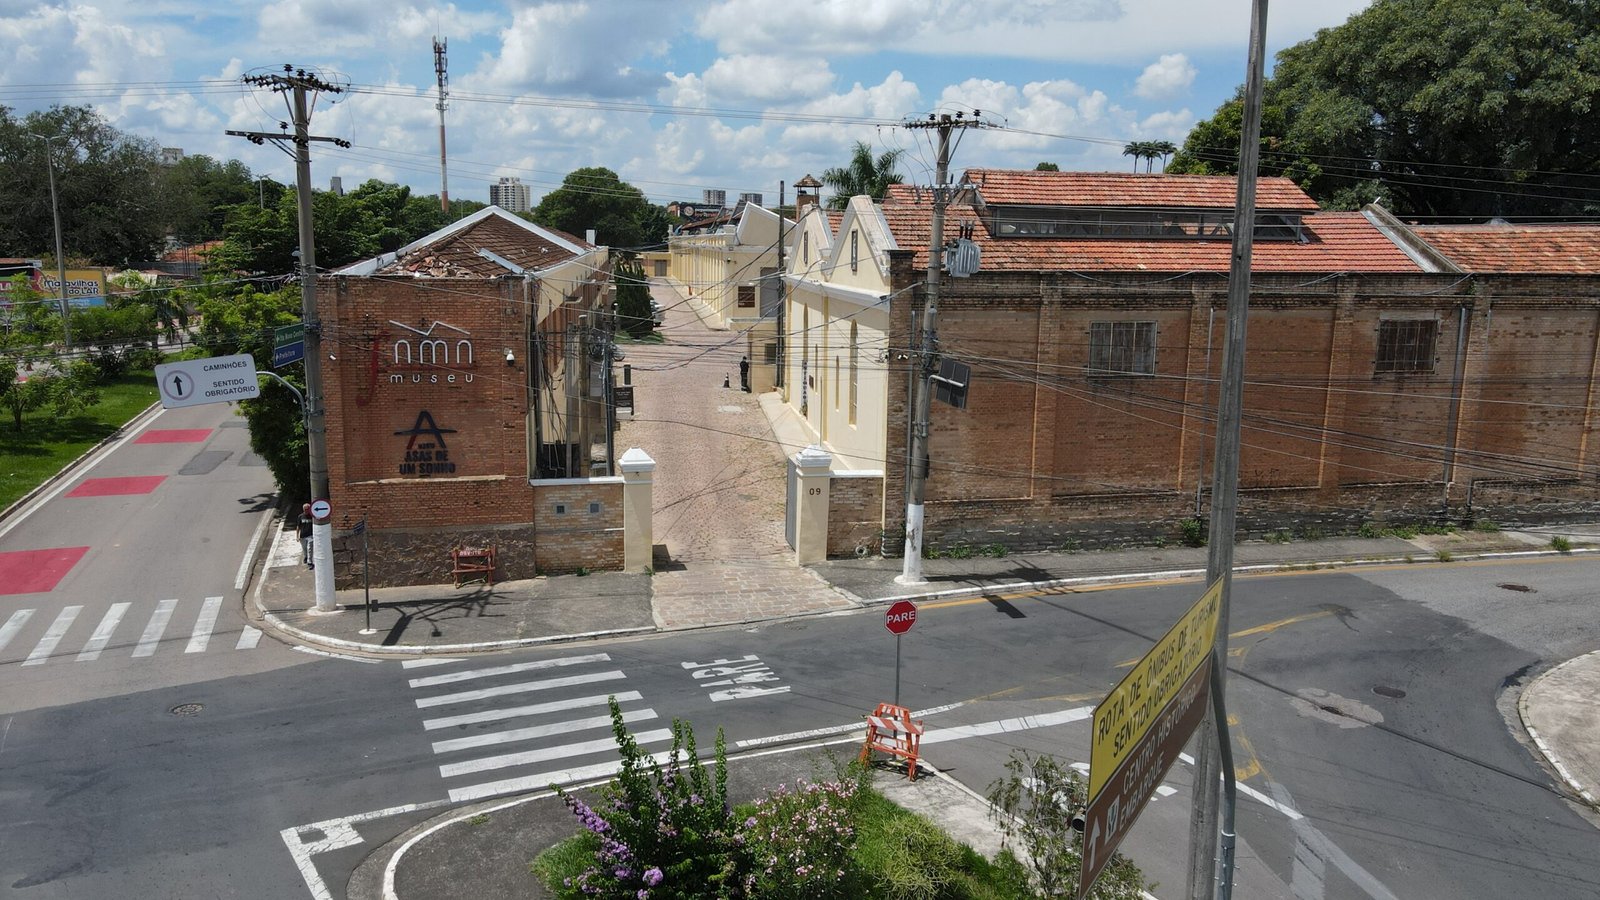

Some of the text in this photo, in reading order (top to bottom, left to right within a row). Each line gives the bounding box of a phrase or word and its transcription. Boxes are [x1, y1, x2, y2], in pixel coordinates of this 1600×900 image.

[68, 287, 99, 295] do LAR
[203, 361, 247, 372] CAMINHÕES
[212, 378, 245, 388] SENTIDO
[390, 374, 473, 383] museu
[205, 385, 256, 398] OBRIGATÓRIO
[404, 450, 449, 462] ASAS DE
[399, 462, 456, 475] UM SONHO
[809, 487, 821, 496] 09
[886, 610, 916, 624] PARE
[1098, 593, 1218, 745] ROTA DE ÔNIBUS DE TURISMO
[1113, 695, 1151, 758] SENTIDO
[1123, 734, 1156, 795] CENTRO
[1119, 752, 1164, 831] EMBARQUE
